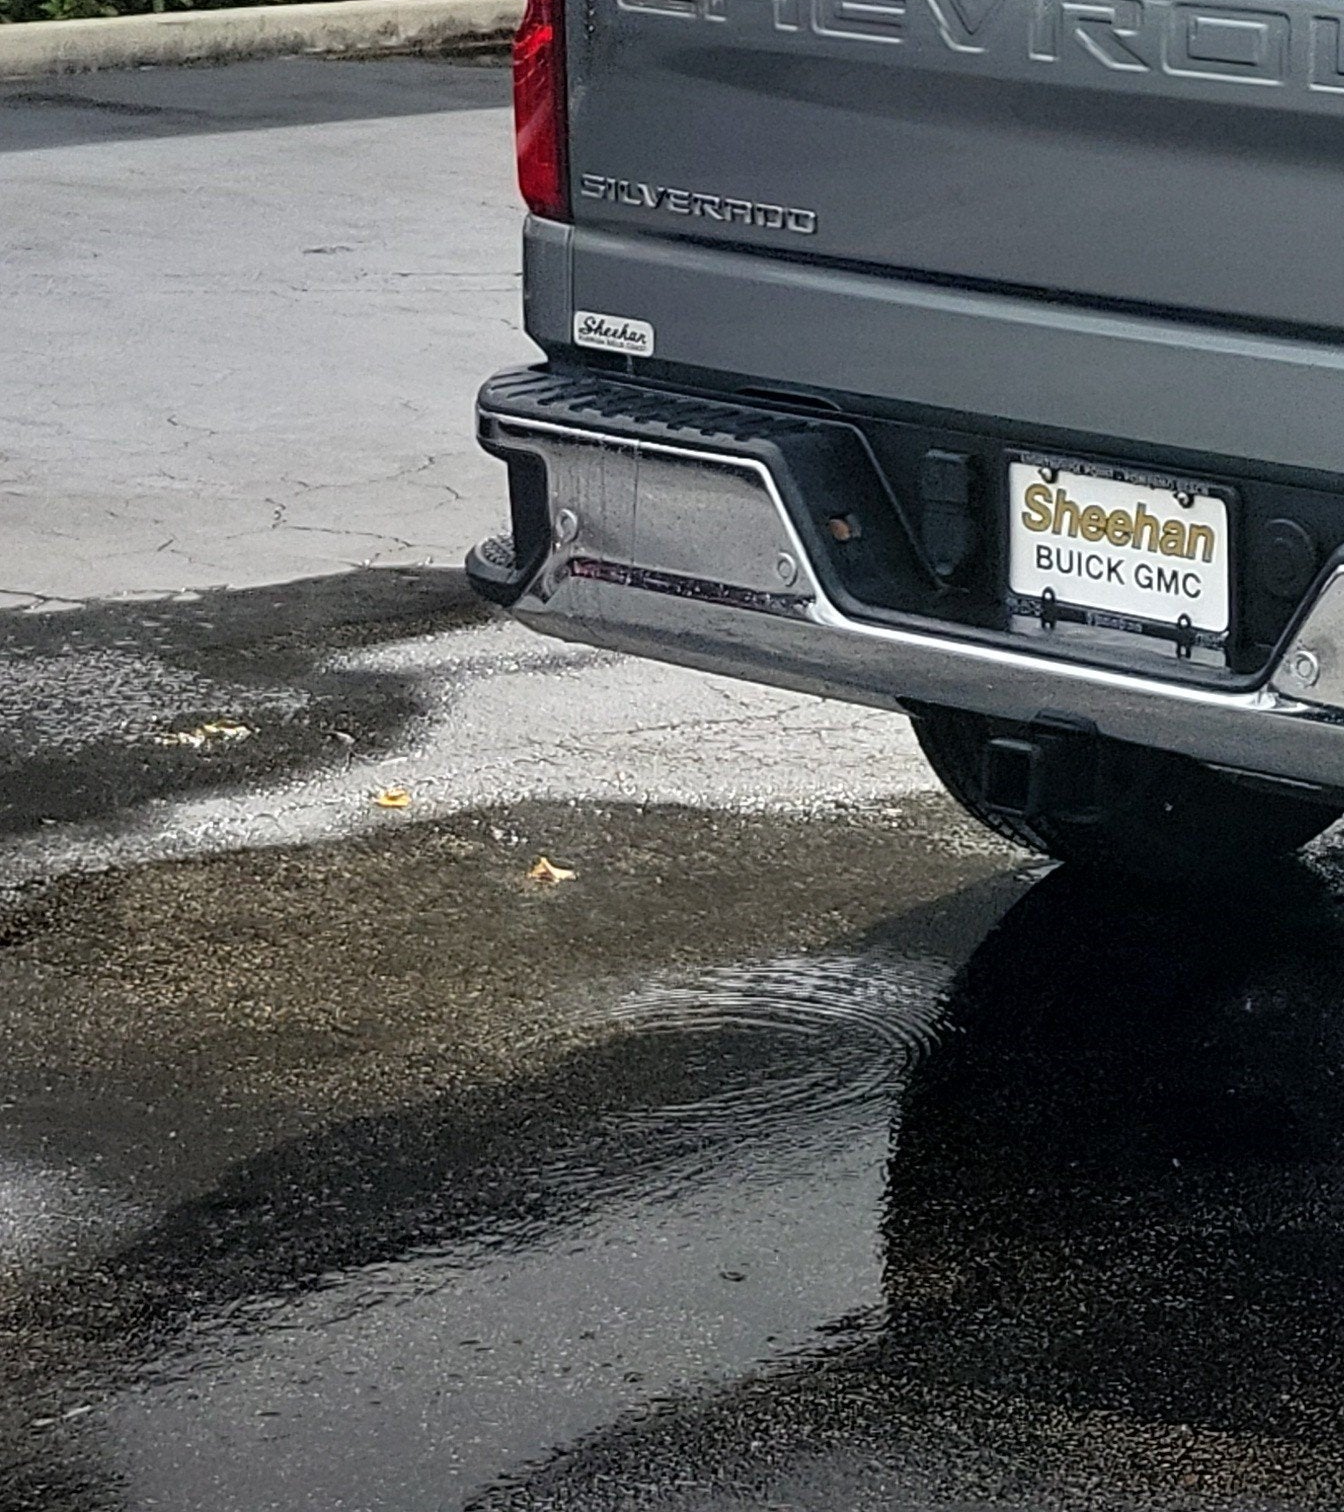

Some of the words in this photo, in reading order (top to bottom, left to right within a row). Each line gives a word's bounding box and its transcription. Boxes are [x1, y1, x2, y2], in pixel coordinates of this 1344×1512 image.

[581, 172, 818, 234] SILVERADO
[578, 315, 647, 345] Sheehan
[1021, 483, 1215, 563] Sheehan
[1036, 544, 1125, 585] BUICK
[1134, 563, 1202, 598] GMC
